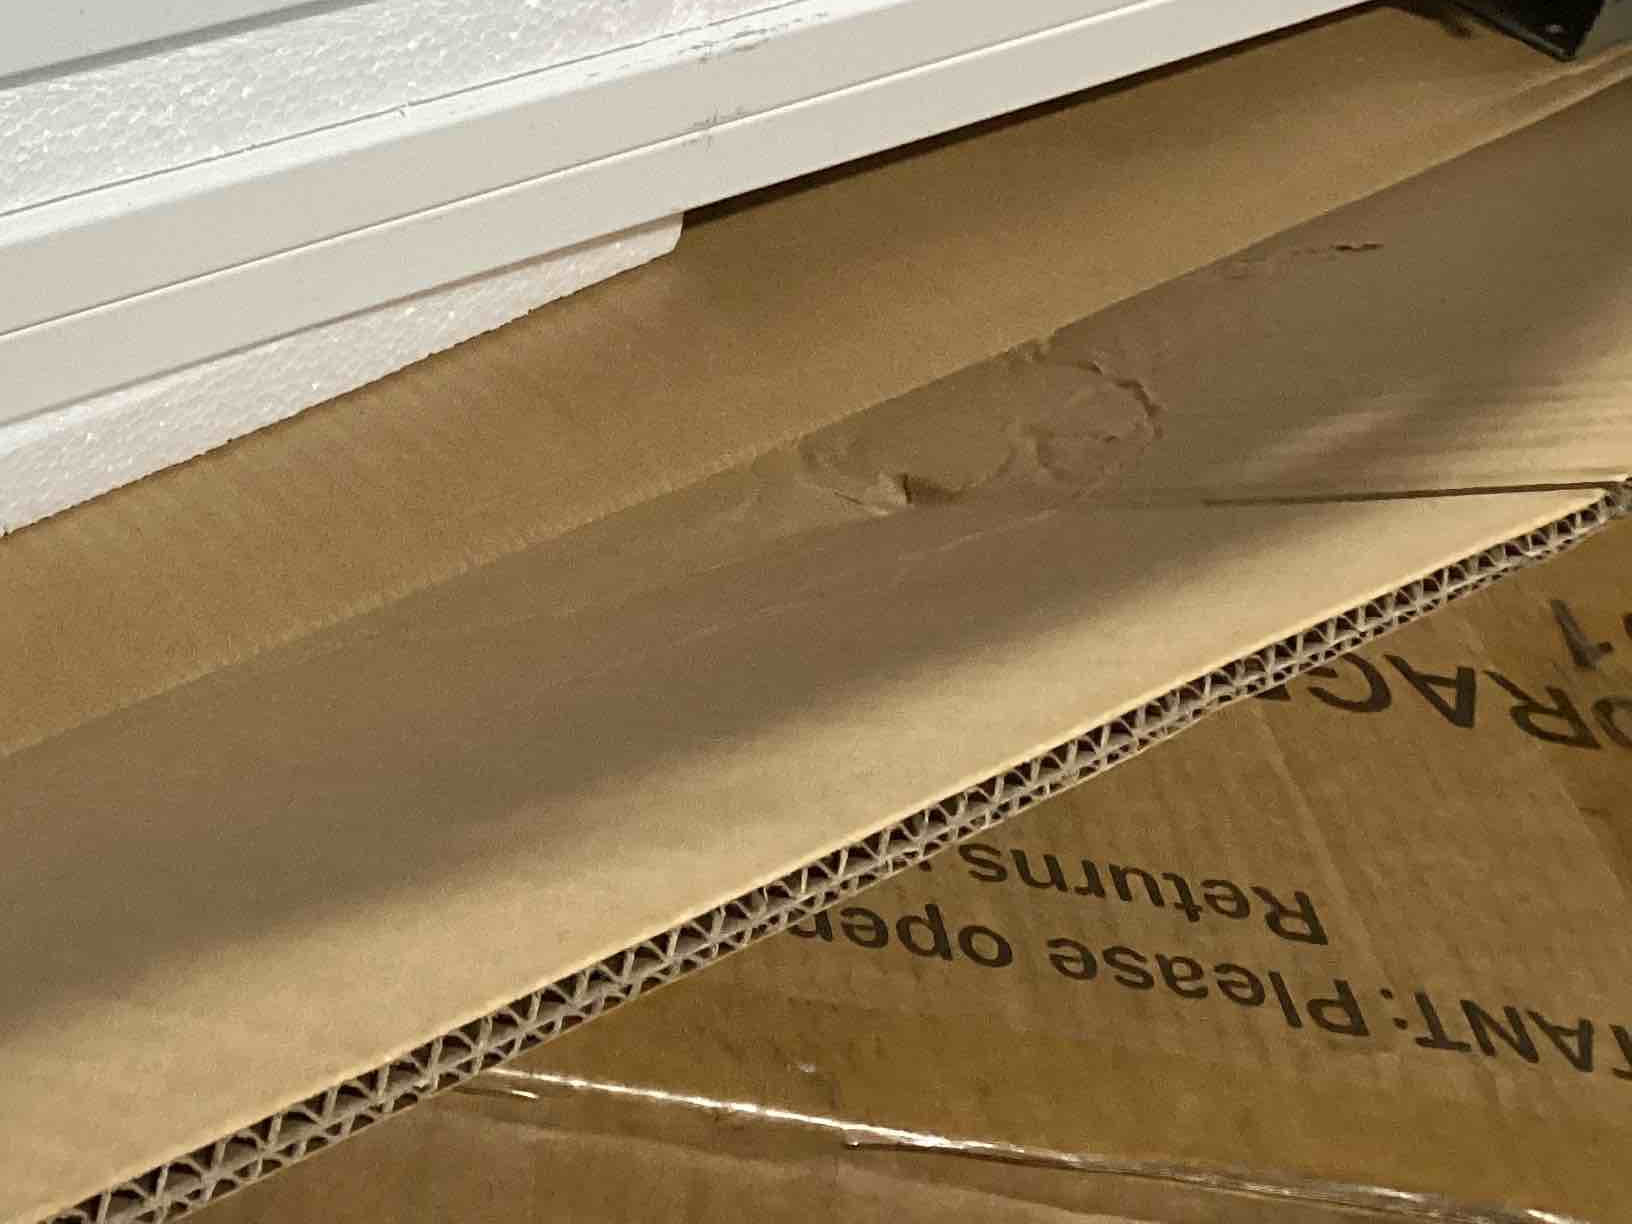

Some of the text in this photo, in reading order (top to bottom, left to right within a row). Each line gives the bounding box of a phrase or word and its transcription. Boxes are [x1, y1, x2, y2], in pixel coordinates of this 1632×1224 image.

[1252, 652, 1632, 751] RAG
[957, 843, 1329, 946] Returns
[1047, 937, 1371, 1038] Please
